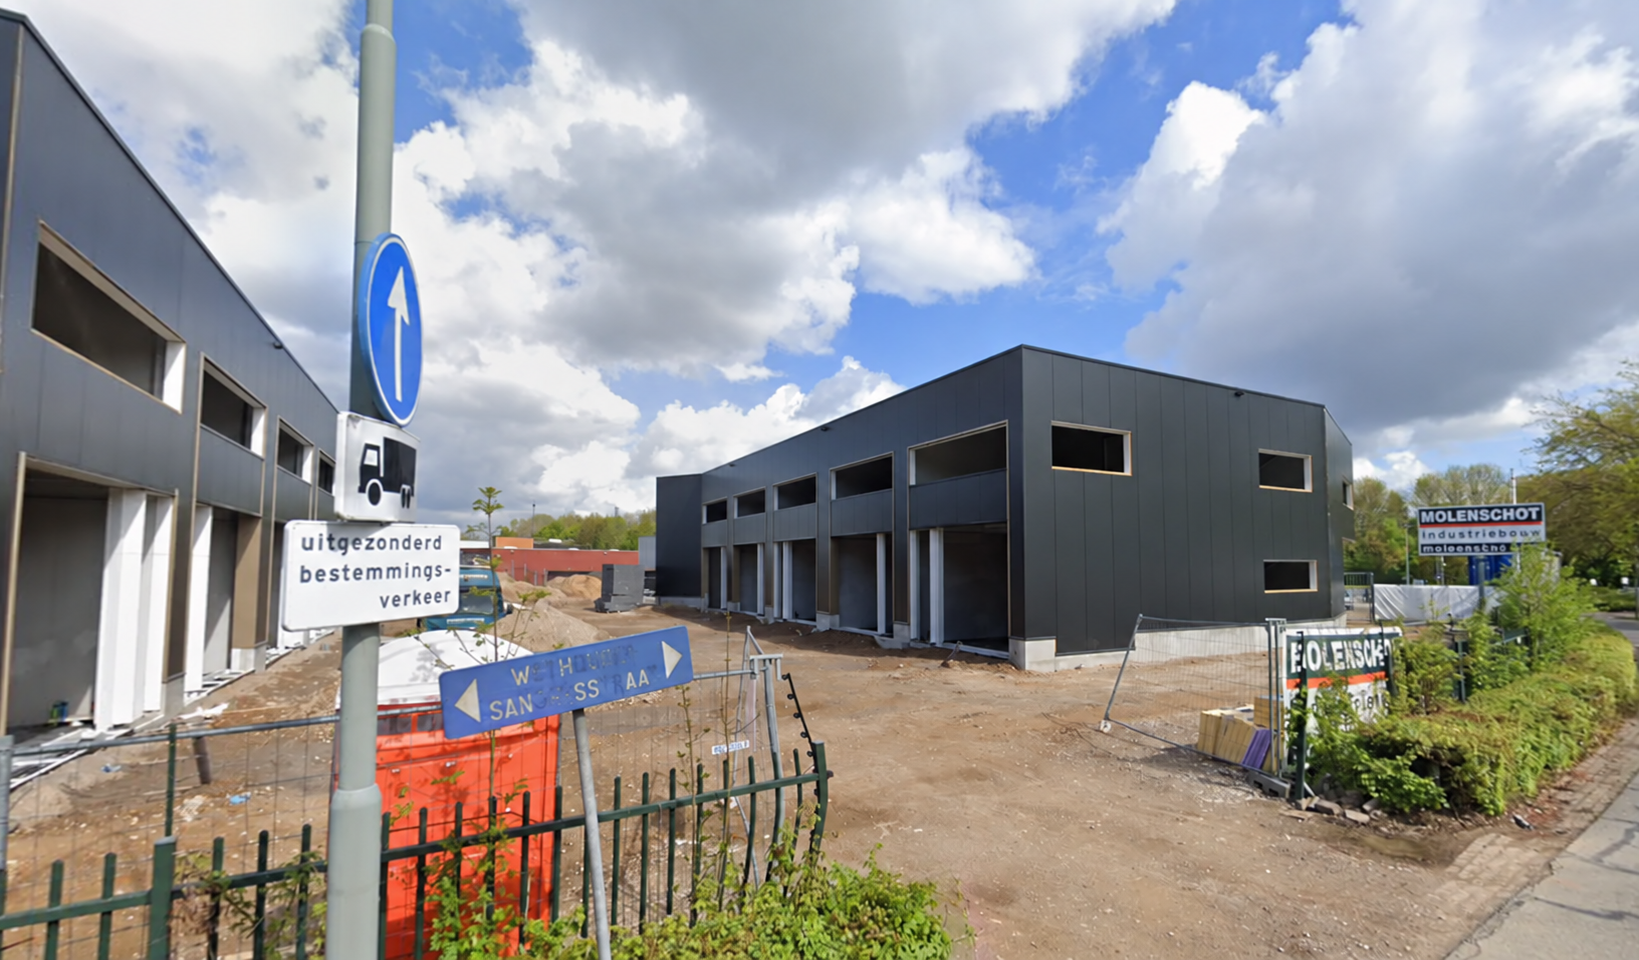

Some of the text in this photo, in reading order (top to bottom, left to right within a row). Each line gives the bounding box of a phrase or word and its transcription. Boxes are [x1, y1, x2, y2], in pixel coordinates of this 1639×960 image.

[1421, 507, 1540, 522] MOLENSCHOT
[301, 533, 442, 556] uitgezonderd
[300, 562, 451, 583] bestemmings-
[379, 590, 451, 608] verkeer
